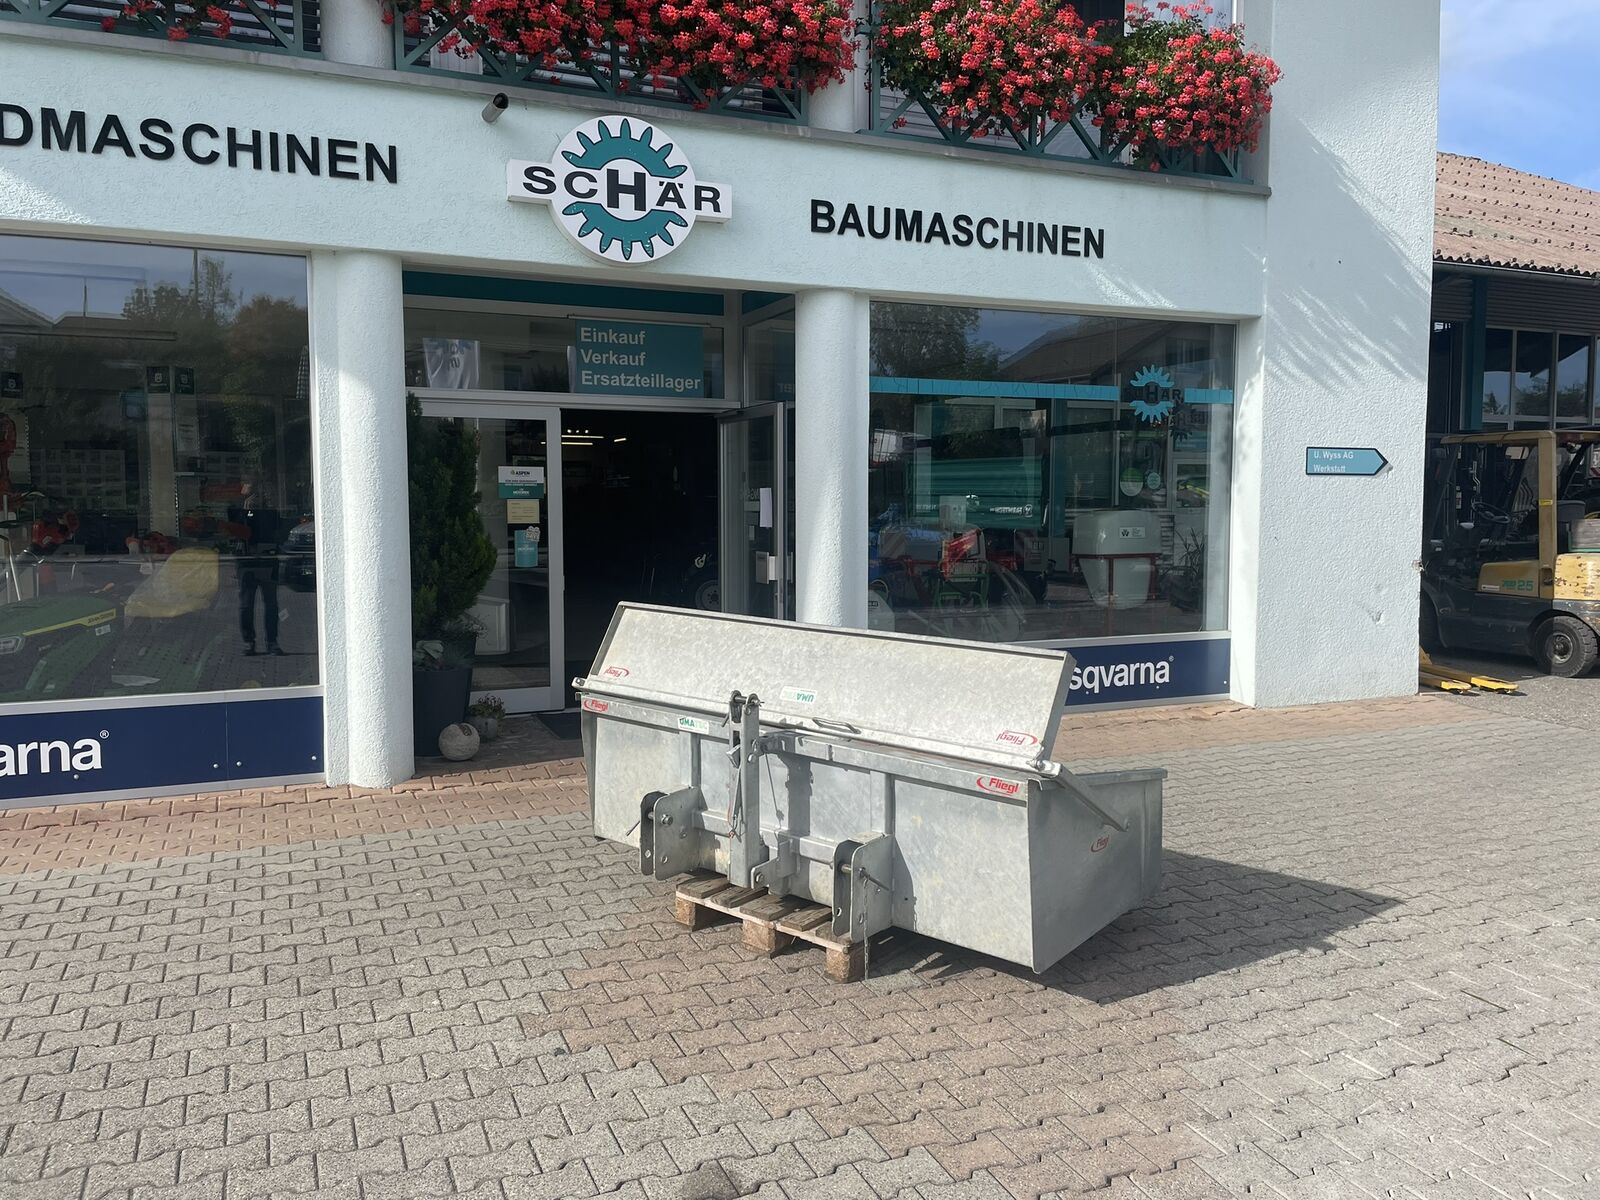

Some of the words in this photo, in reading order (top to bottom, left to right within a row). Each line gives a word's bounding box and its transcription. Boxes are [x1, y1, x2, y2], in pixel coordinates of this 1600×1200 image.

[0, 102, 398, 184] DMASCHINEN
[522, 165, 721, 213] SCHÄR
[810, 199, 1105, 259] BAUMASCHINEN
[580, 327, 646, 345] Einkauf
[580, 349, 647, 366] Verkauf
[581, 370, 701, 392] Ersatzteillager
[1322, 450, 1341, 460] Wyss
[1342, 451, 1354, 459] AG
[996, 731, 1026, 746] Fliegl
[988, 777, 1019, 794] Fliegl
